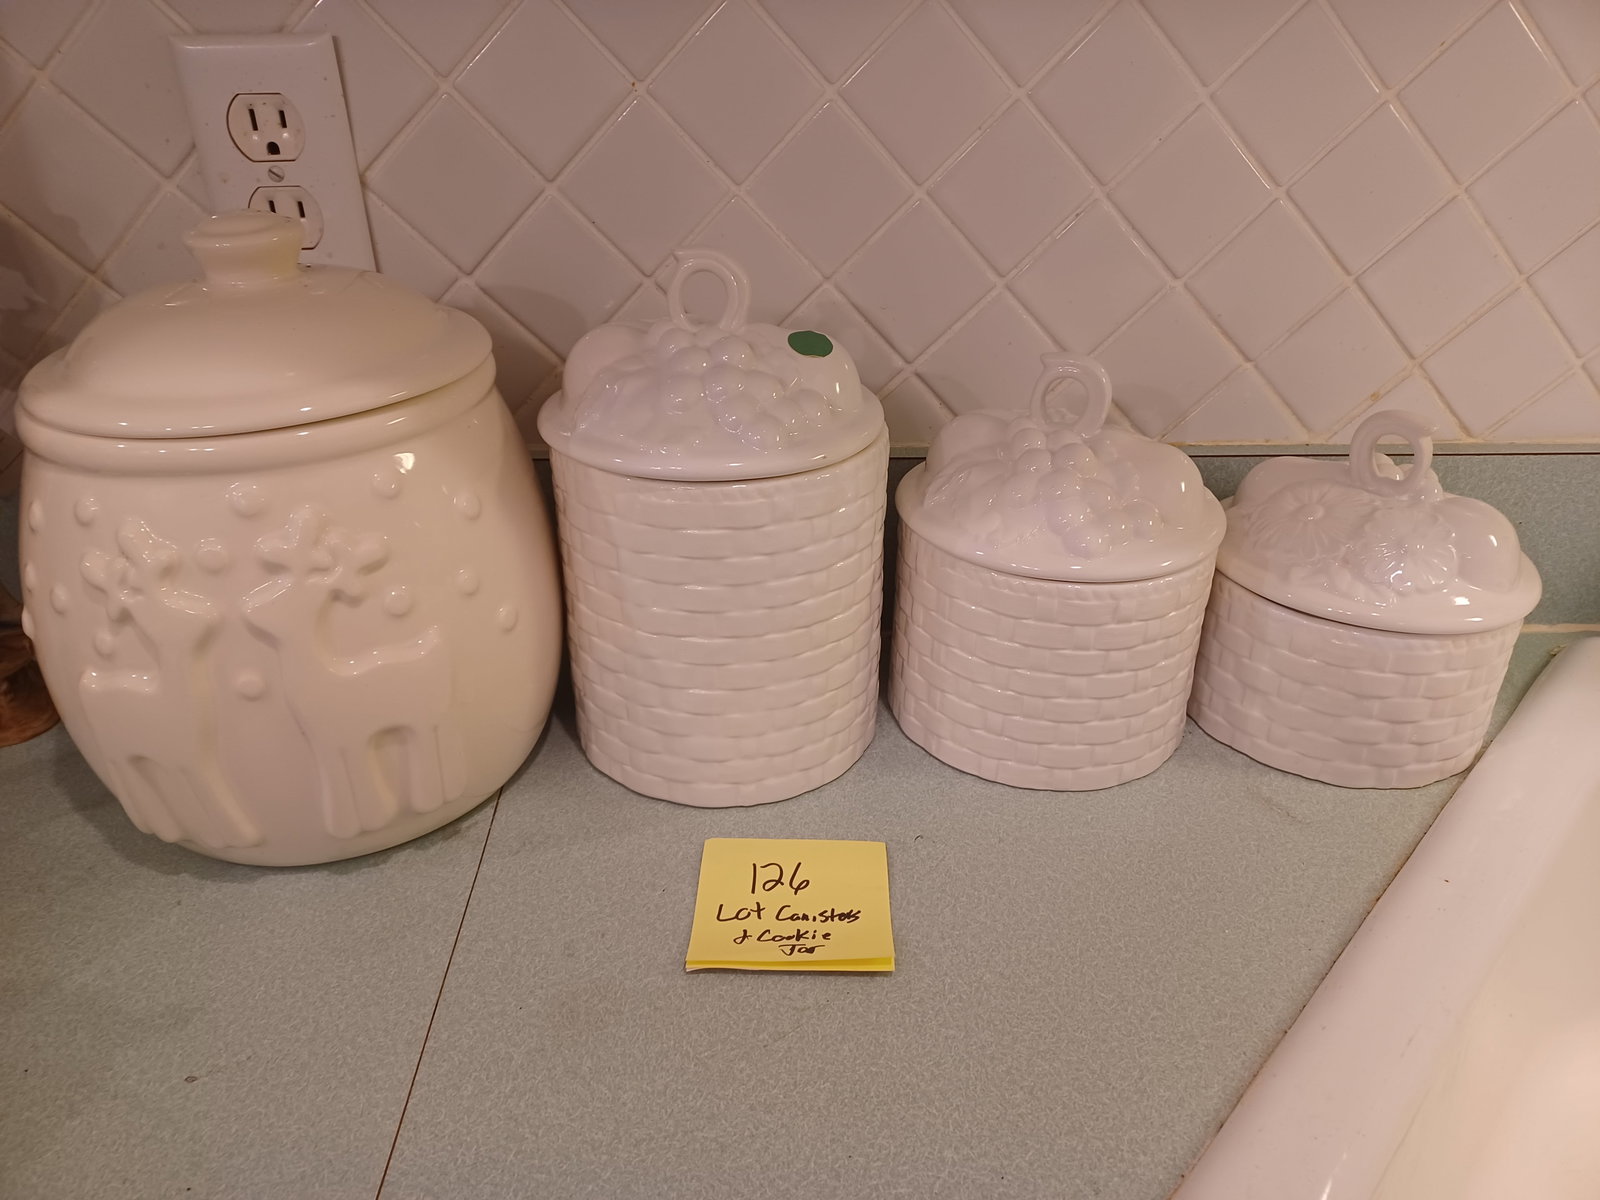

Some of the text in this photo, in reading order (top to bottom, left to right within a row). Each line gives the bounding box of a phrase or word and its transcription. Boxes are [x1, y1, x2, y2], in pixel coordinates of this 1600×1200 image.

[750, 861, 810, 896] 126
[716, 901, 766, 922] Lot
[756, 928, 832, 943] Cookie
[778, 943, 826, 957] Jar
